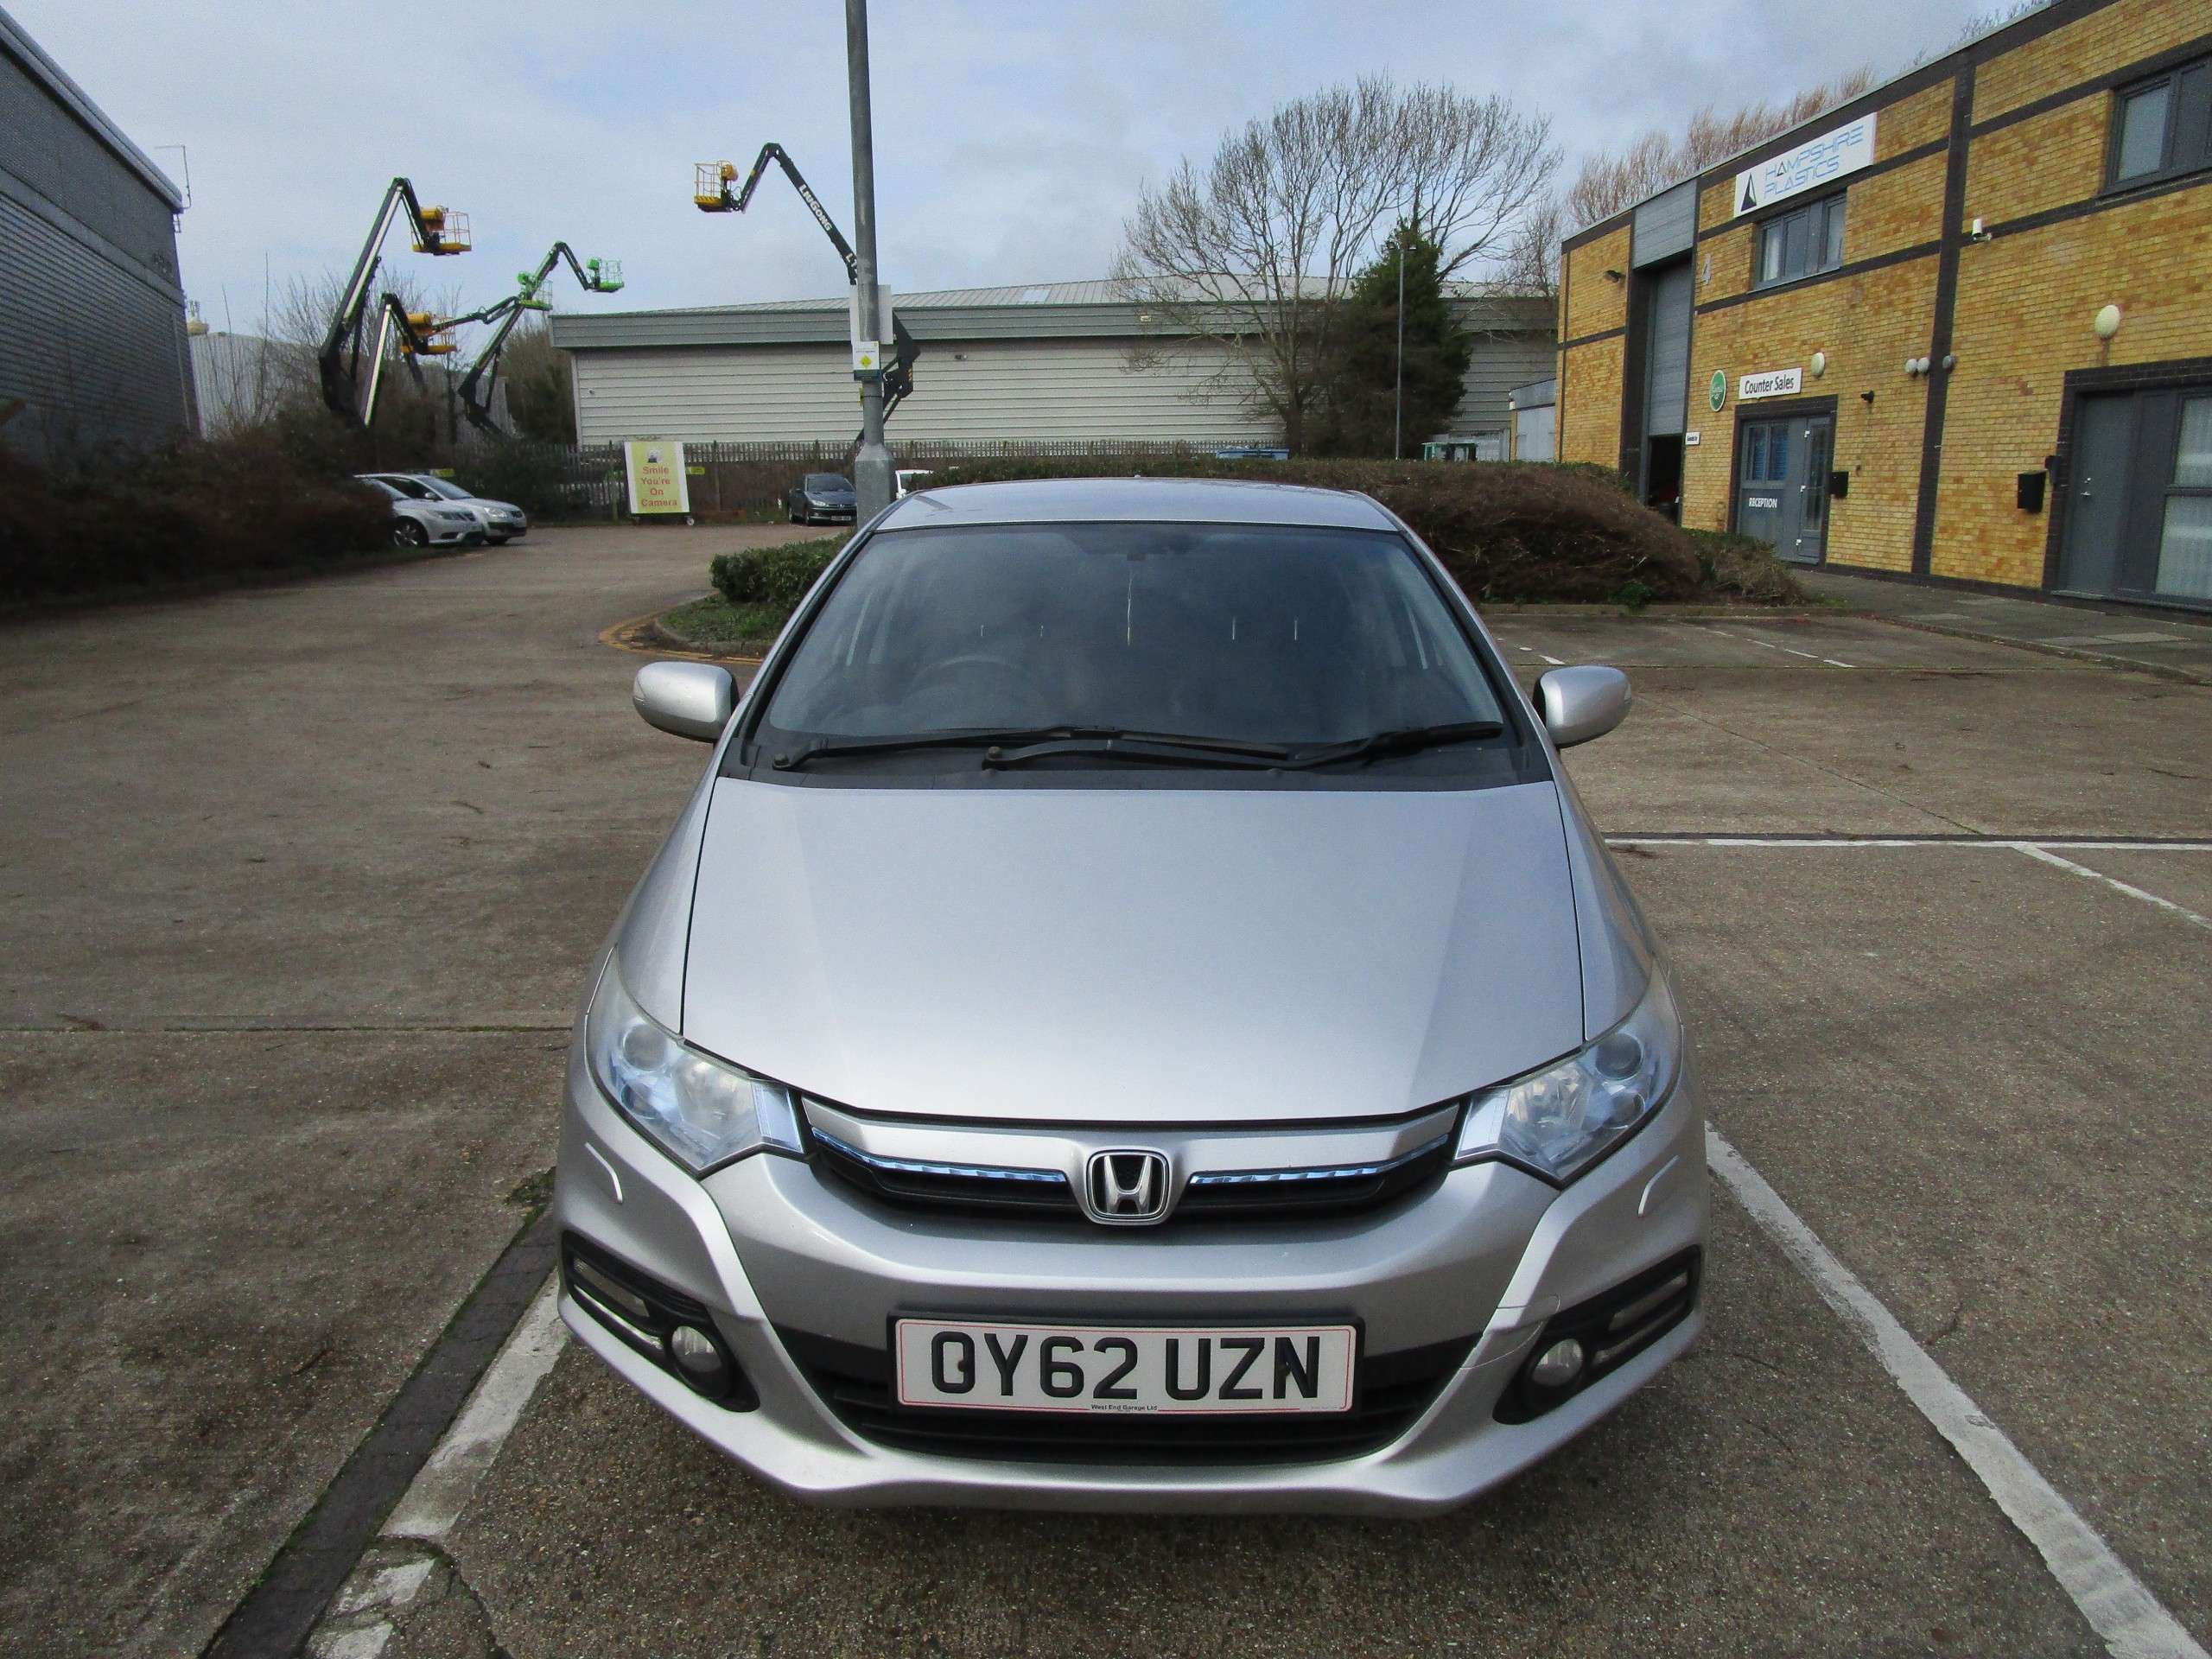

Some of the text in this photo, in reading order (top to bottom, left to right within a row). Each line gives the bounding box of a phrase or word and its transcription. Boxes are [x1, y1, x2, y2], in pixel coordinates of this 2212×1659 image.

[1765, 125, 1864, 181] HAMPSHIRE
[1764, 156, 1840, 200] PLASTICS
[1745, 374, 1795, 394] Counter Sales
[642, 466, 669, 474] Smile
[641, 499, 677, 507] Camera
[1748, 497, 1777, 508] RECEPTION
[1165, 1336, 1320, 1401] UZN
